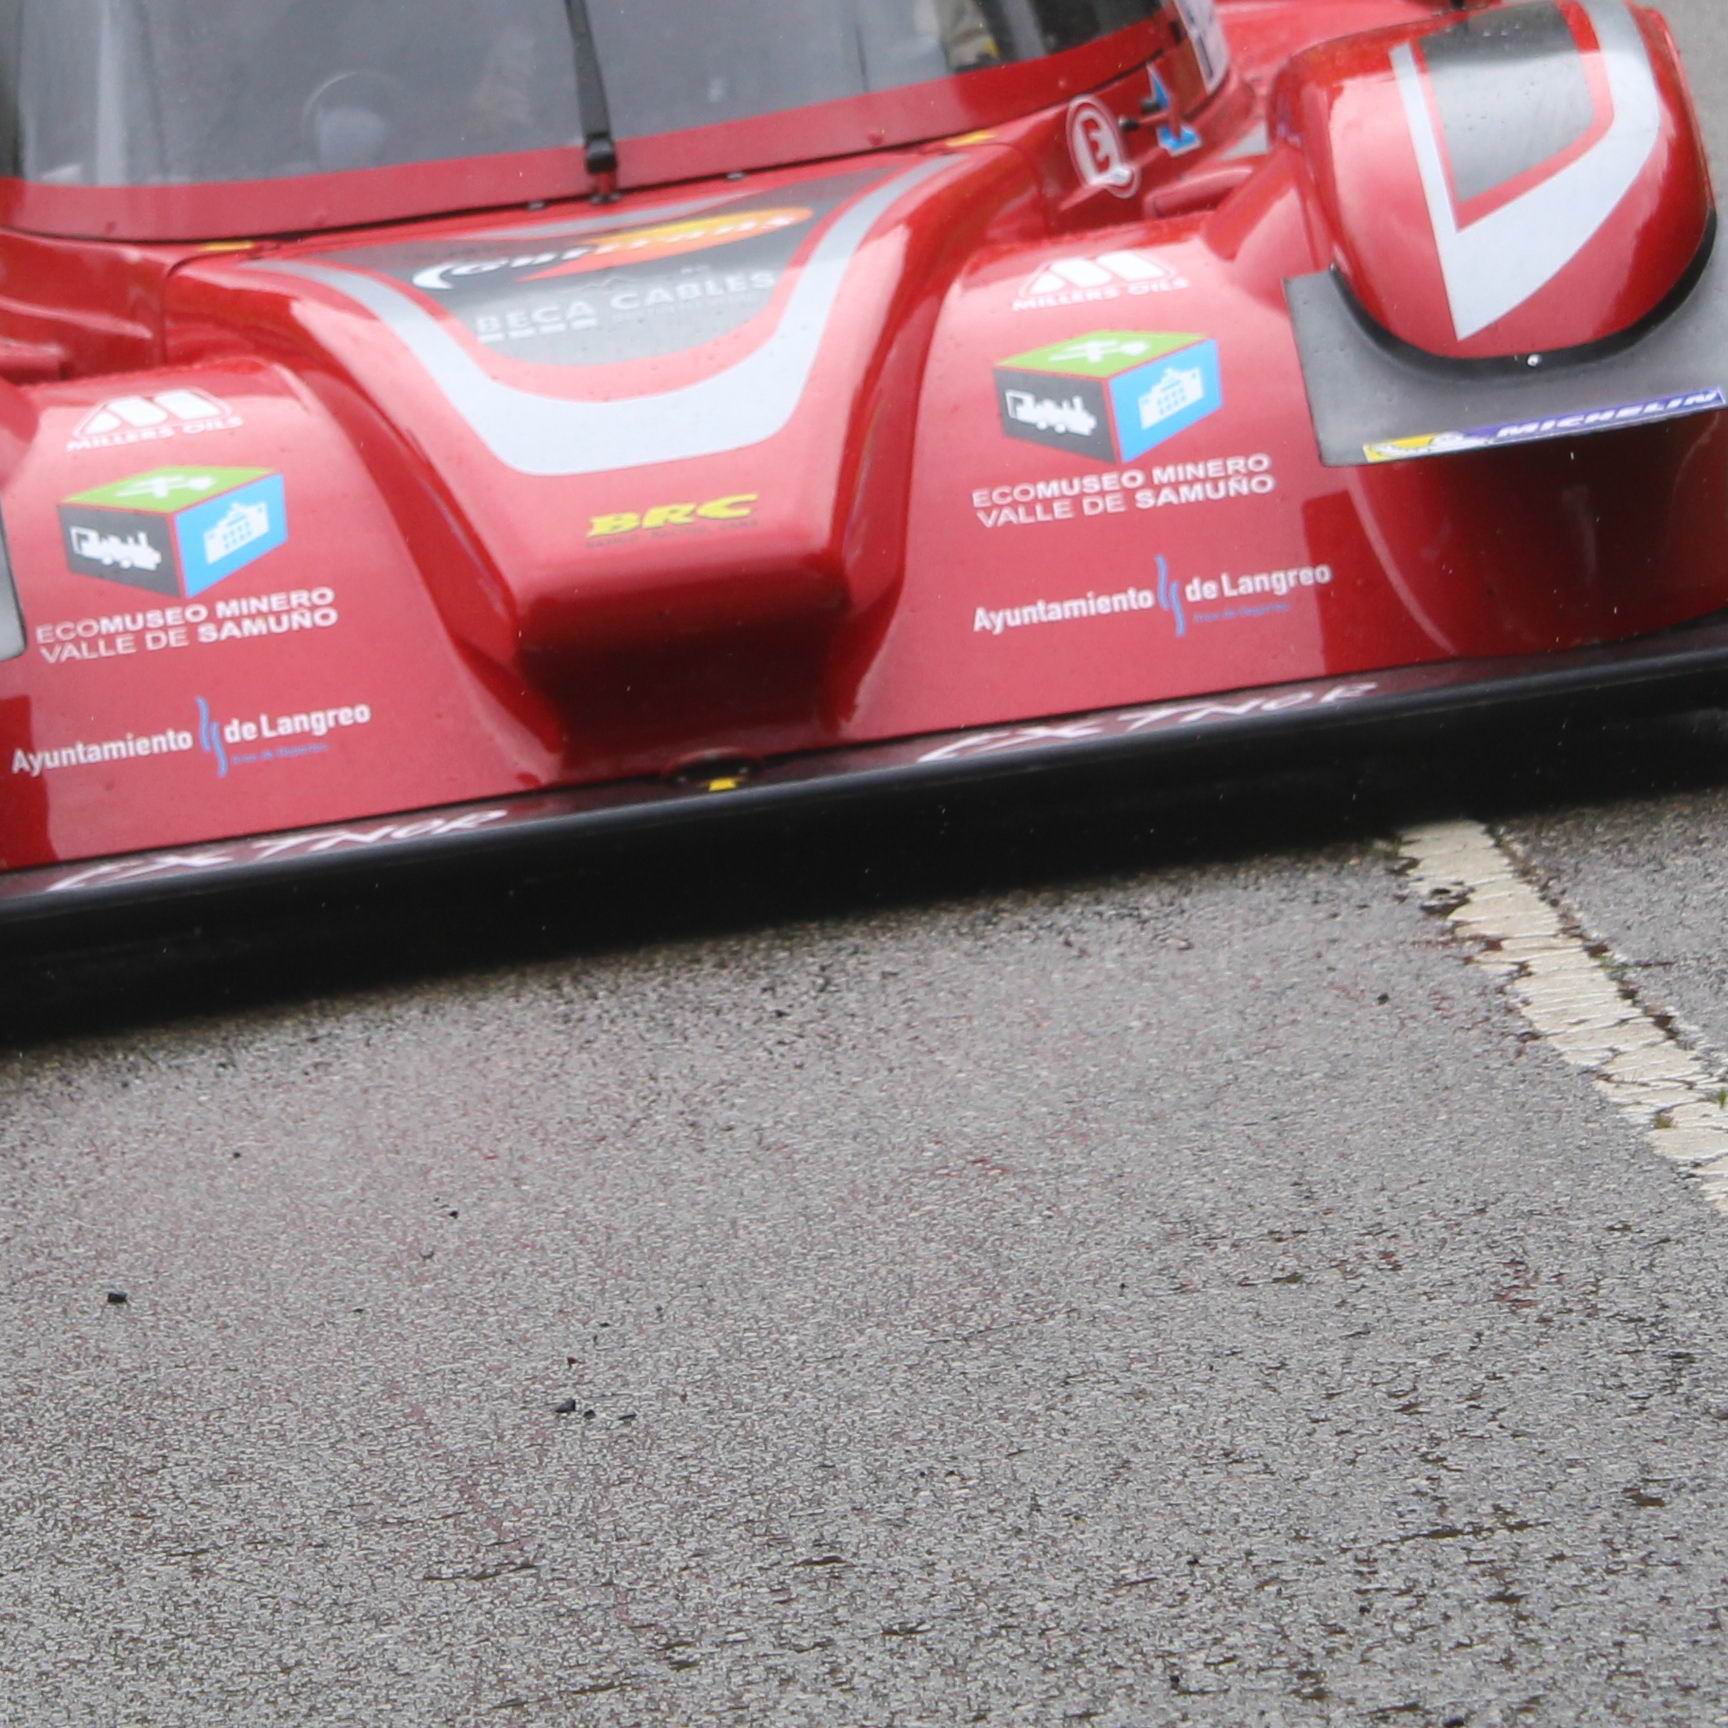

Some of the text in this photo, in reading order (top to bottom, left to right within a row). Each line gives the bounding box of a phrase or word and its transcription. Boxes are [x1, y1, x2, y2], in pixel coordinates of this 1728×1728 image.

[477, 271, 778, 335] BECA CABLES
[1011, 288, 1120, 312] MILLERS
[67, 416, 243, 452] MILLERS OILS
[1496, 389, 1722, 438] MICHELIN
[972, 452, 1270, 509] ECOMUSEO MINERO
[976, 474, 1275, 528] VALLE DE SAMUÑO
[586, 493, 758, 538] BRC
[36, 586, 335, 645] ECOMUSEO MINERO
[973, 588, 1153, 634] Ayuntamiento
[1185, 576, 1218, 602] de
[1221, 564, 1332, 600] Langreo
[39, 607, 338, 664] VALLE DE SAMUÑO
[11, 729, 193, 776] Ayuntamiento
[224, 716, 257, 743] de
[260, 704, 371, 743] Langreo
